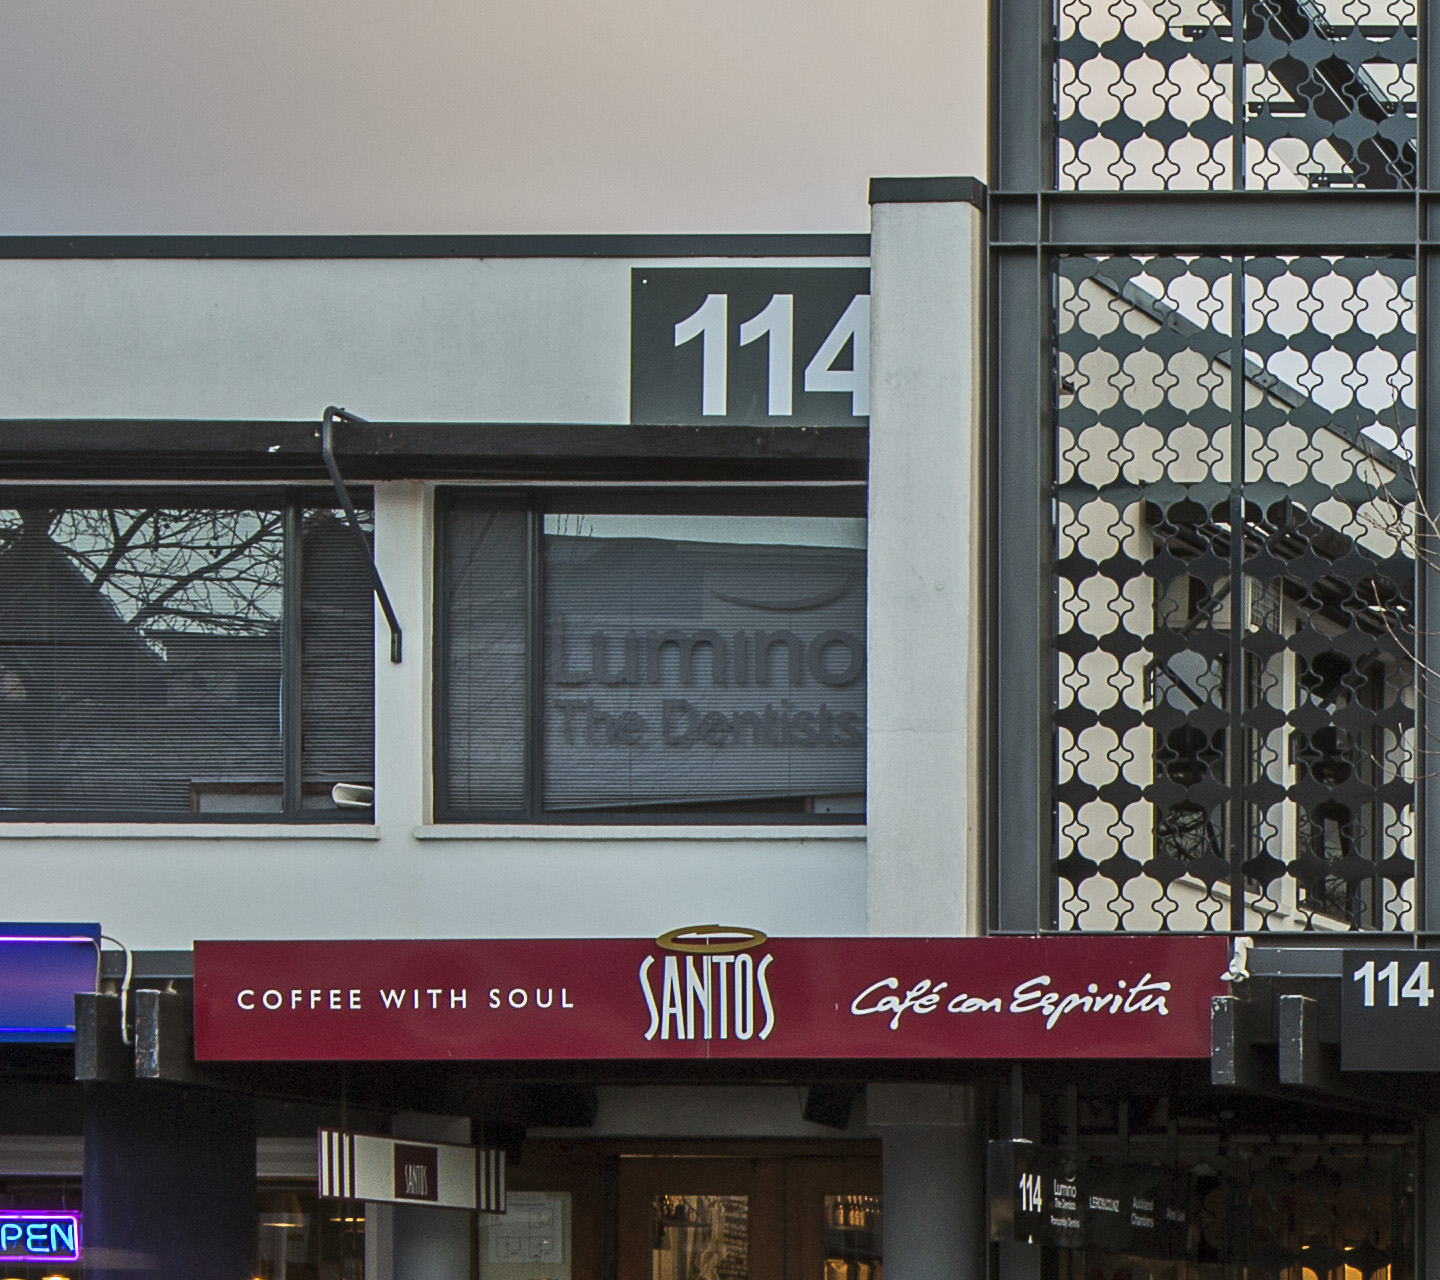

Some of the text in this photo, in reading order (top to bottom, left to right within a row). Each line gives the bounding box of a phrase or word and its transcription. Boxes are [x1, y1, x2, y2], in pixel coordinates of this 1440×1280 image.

[675, 294, 870, 416] 114
[548, 610, 865, 688] Lumino
[553, 697, 862, 748] The Dentists
[237, 988, 574, 1010] COFFEE WITH SOUL
[639, 953, 775, 1041] SANTOS
[851, 977, 948, 1030] Café
[947, 993, 1001, 1013] con
[1353, 961, 1434, 1008] 114
[1019, 1173, 1042, 1212] 114
[1, 1223, 74, 1253] PEN
